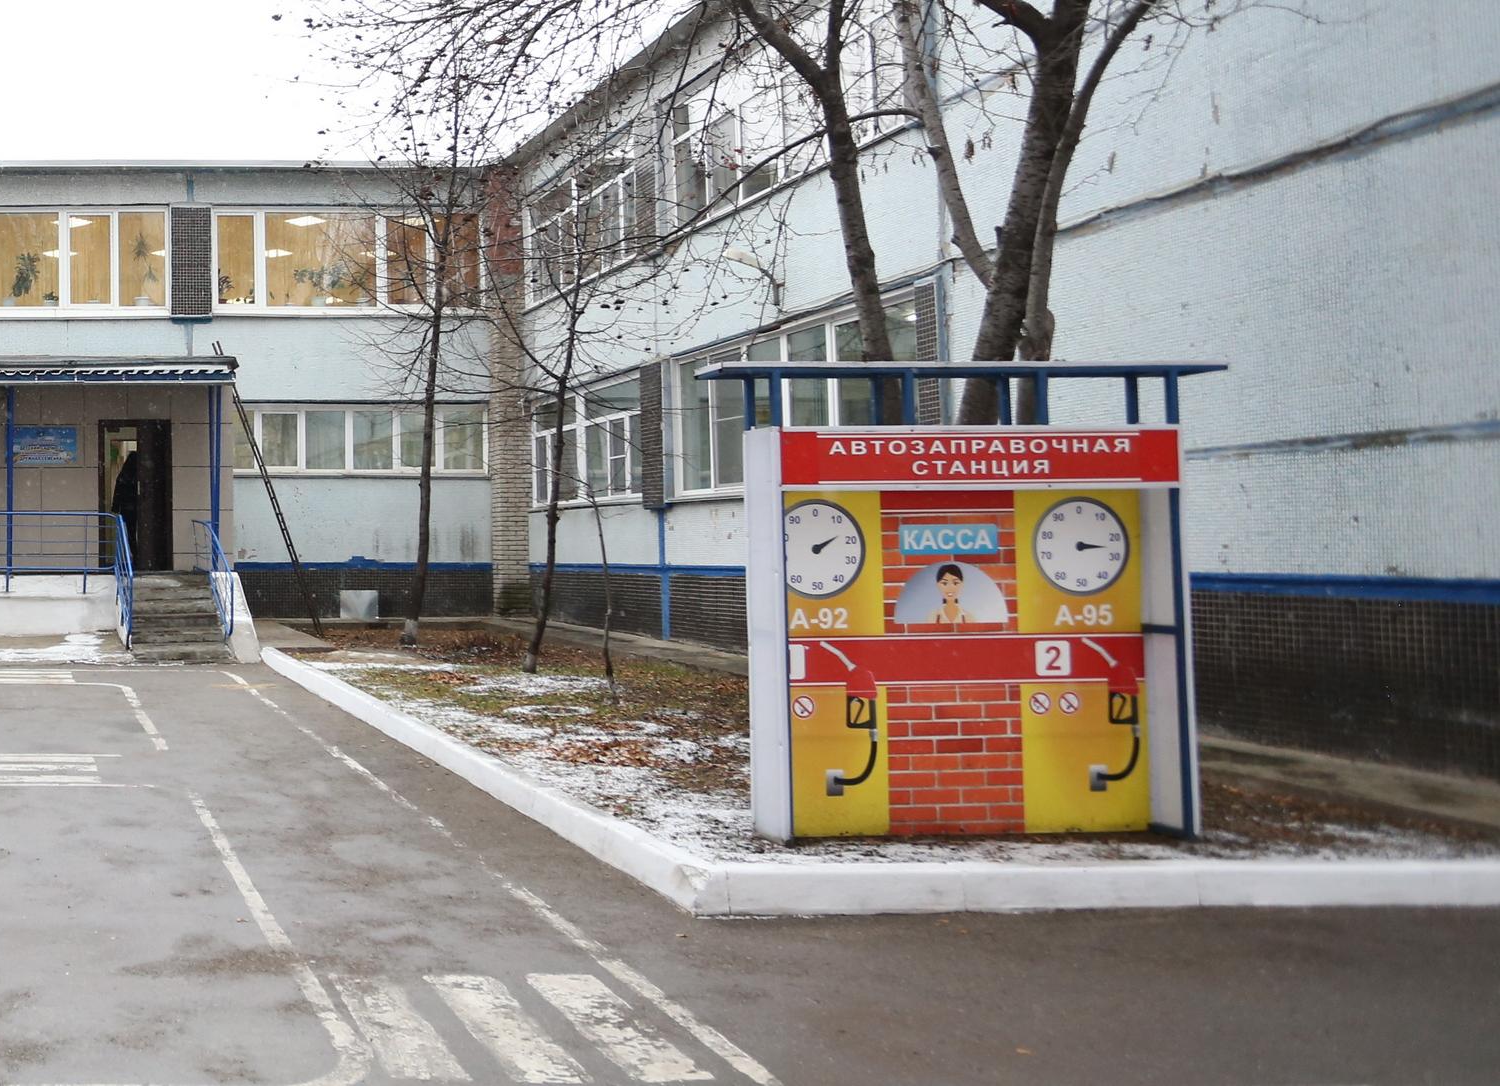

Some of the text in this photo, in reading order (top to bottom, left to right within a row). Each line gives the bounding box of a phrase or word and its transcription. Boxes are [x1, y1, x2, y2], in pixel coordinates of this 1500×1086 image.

[828, 438, 1131, 456] АВТОЗАПРАВОЧНАЯ
[911, 459, 1050, 478] СТАНЦИЯ
[812, 508, 819, 517] 0
[1075, 506, 1082, 514] 0
[788, 515, 801, 524] 90
[831, 515, 843, 524] 10
[1052, 513, 1065, 522] 90
[1095, 513, 1106, 521] 10
[903, 528, 994, 550] КАССА
[1041, 531, 1053, 540] 80
[1109, 533, 1121, 542] 20
[845, 536, 857, 545] 20
[1040, 551, 1052, 560] 70
[1109, 553, 1121, 561] 30
[845, 556, 857, 565] 30
[790, 575, 802, 584] 60
[832, 575, 845, 583] 40
[1054, 572, 1067, 580] 60
[1096, 571, 1109, 580] 40
[812, 582, 824, 590] 50
[1076, 578, 1088, 587] 50
[789, 608, 848, 630] А-92
[1054, 604, 1113, 626] А-95
[1045, 646, 1061, 671] 2
